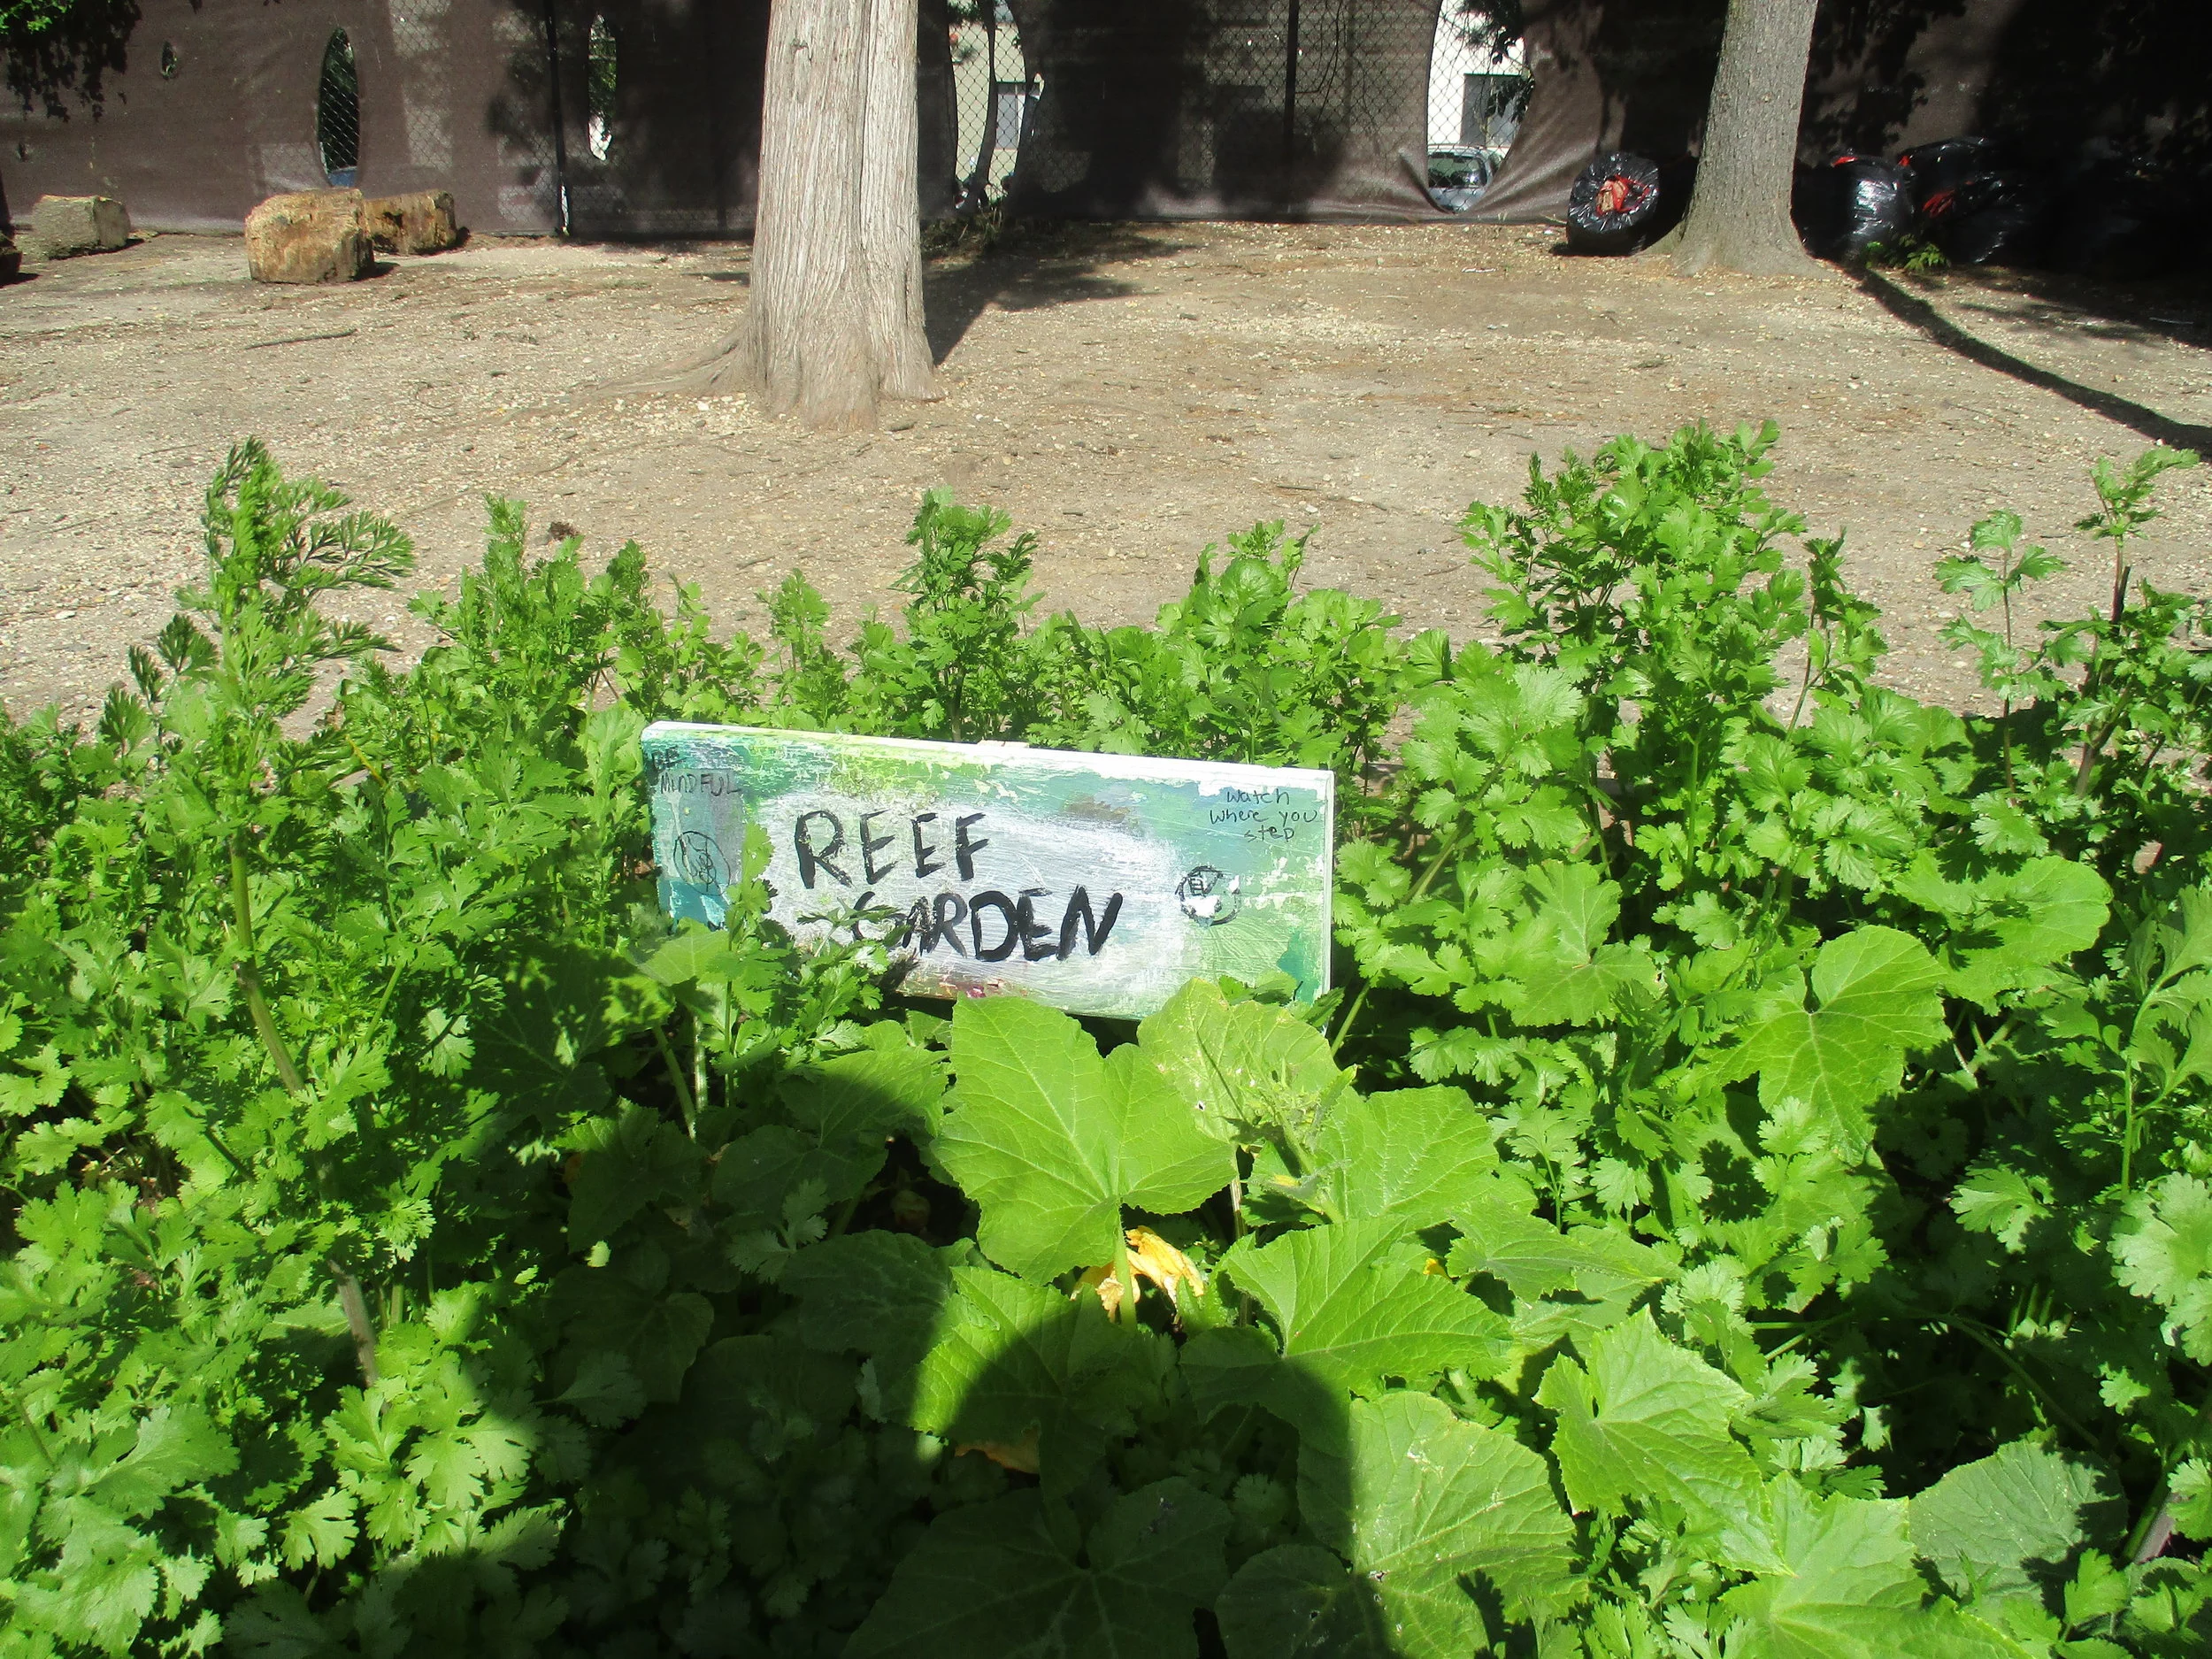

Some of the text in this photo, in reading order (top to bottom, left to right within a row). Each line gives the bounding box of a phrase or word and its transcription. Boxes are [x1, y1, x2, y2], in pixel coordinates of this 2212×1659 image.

[1279, 810, 1317, 827] you
[1243, 825, 1295, 843] step
[794, 809, 990, 889] REEF
